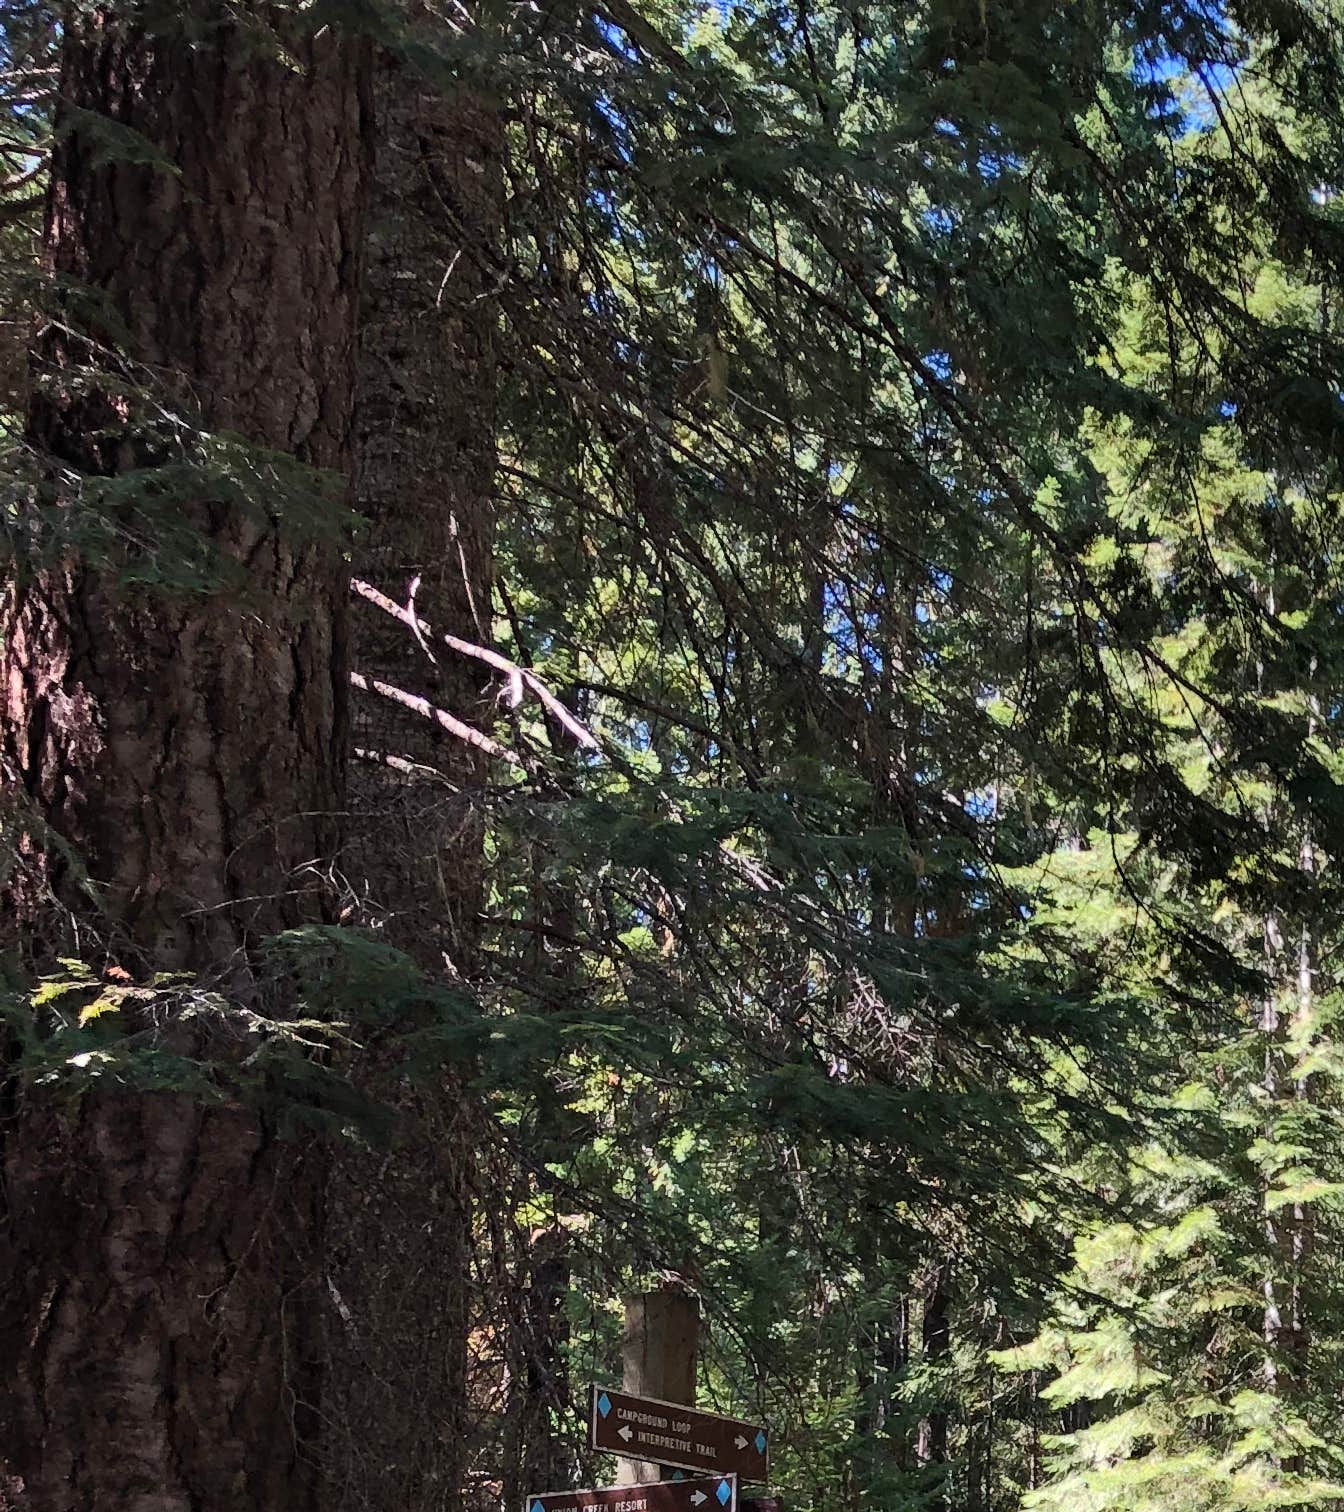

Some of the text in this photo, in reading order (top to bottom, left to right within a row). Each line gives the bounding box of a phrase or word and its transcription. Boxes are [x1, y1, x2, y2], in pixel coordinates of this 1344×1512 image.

[617, 1407, 691, 1434] CAMPGROUND LOOP
[638, 1431, 717, 1458] INTERPRETIVE TRAIL
[615, 1499, 648, 1512] RESORT
